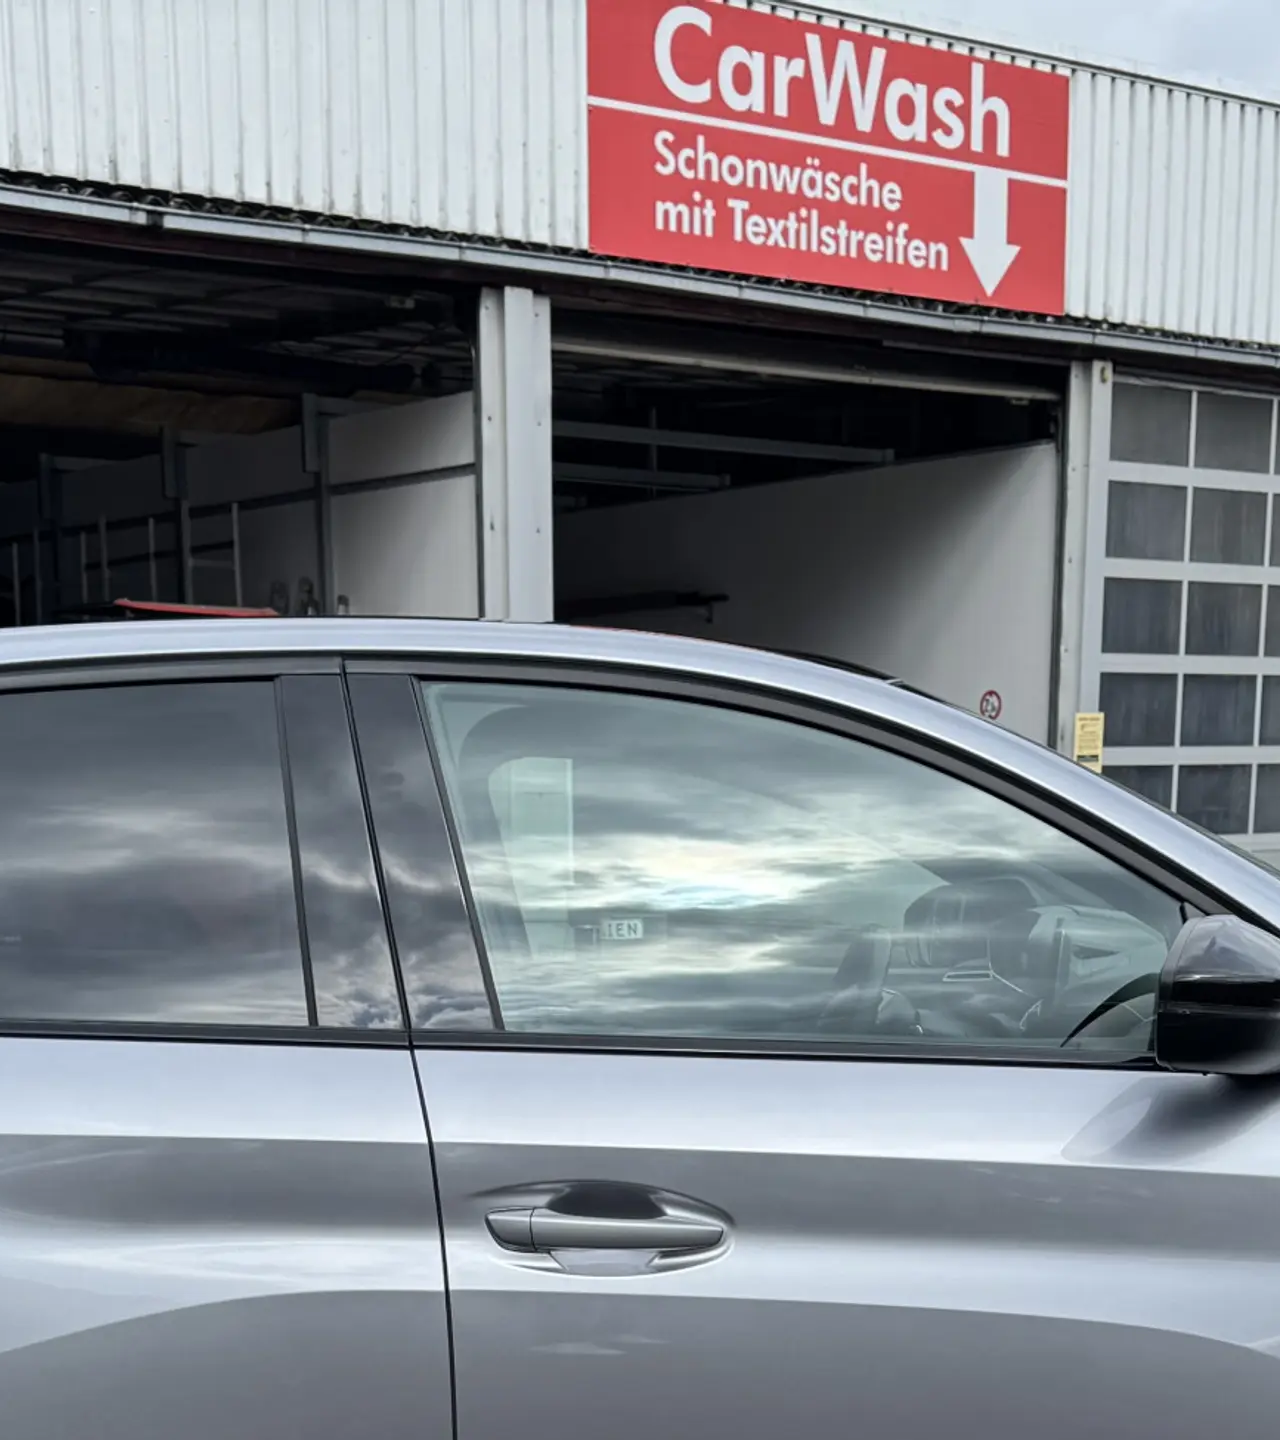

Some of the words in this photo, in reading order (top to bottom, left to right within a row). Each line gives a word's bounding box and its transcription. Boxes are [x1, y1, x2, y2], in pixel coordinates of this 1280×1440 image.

[654, 5, 1010, 157] CarWash
[654, 130, 903, 212] Schonwäsche
[655, 191, 716, 238] mit
[728, 197, 949, 272] Textilstreifen
